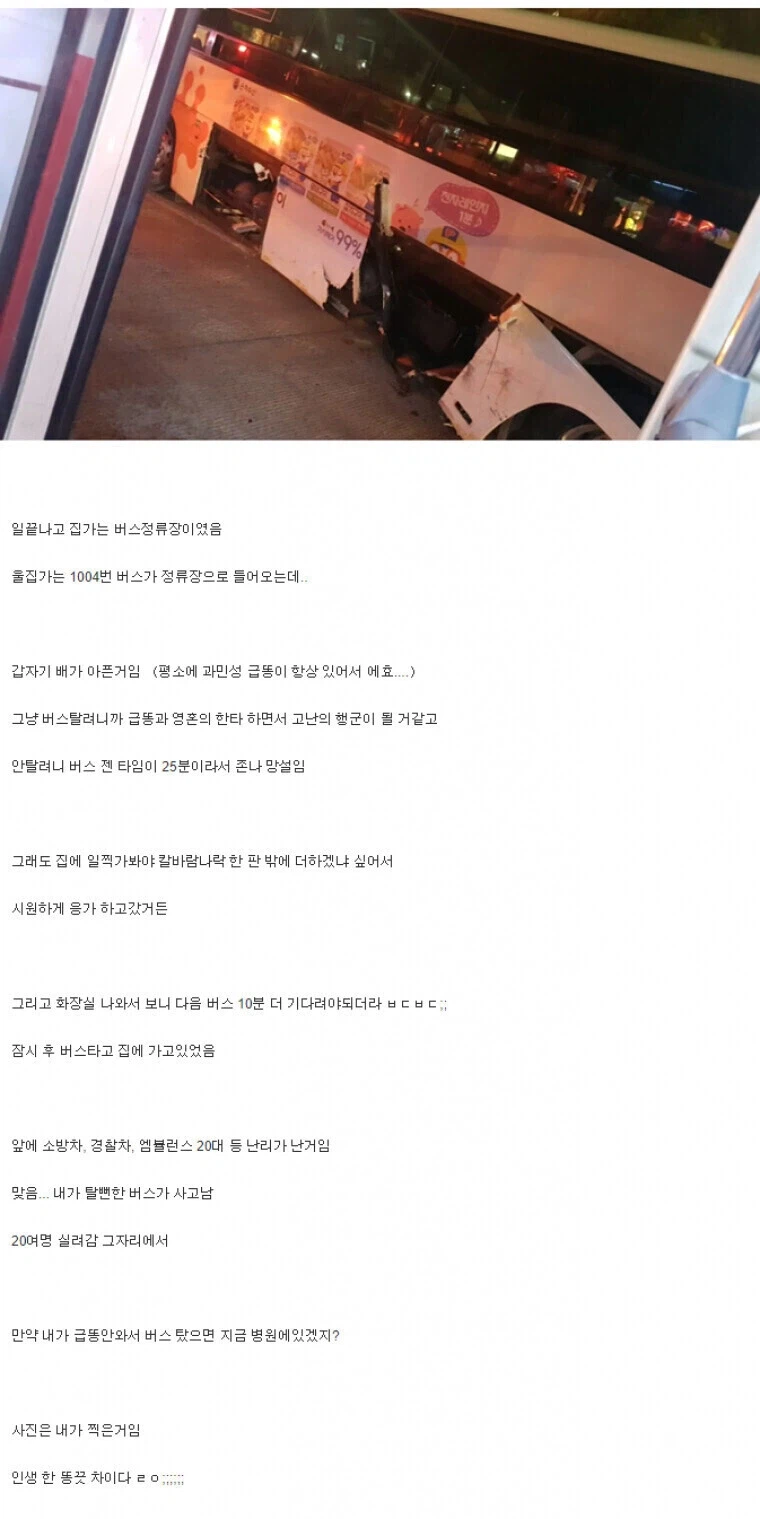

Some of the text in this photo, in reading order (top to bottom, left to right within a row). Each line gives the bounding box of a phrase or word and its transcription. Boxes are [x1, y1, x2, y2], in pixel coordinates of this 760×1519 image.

[336, 228, 363, 260] 99%
[11, 522, 223, 537] 일끝나고 집가는 버스정류장이였음
[11, 569, 66, 584] 울집가는
[70, 569, 112, 584] 1004번
[116, 569, 158, 584] 버스가
[160, 569, 229, 584] 정류장으로
[11, 759, 305, 774] 안탈려니 버스 젠 타임이 25분이라서 존나 망설임
[11, 901, 168, 916] 시원하게 응가 하고갔거든
[11, 1043, 216, 1058] 잠시 후 버스타고 집에 가고있었음
[11, 1138, 37, 1153] 앞에
[139, 1138, 193, 1153] 엠뷸런스
[196, 1138, 224, 1153] 20대
[229, 1138, 243, 1153] 등
[246, 1138, 288, 1153] 난리가
[290, 1138, 330, 1153] 난거임
[53, 1186, 81, 1201] 내가
[85, 1186, 127, 1201] 탈뻔한
[129, 1186, 171, 1201] 버스가
[173, 1186, 215, 1201] 사고남
[10, 1233, 168, 1248] 20여명 실려감 그자리에서
[11, 1423, 140, 1438] 사진은 내가 찍은거임
